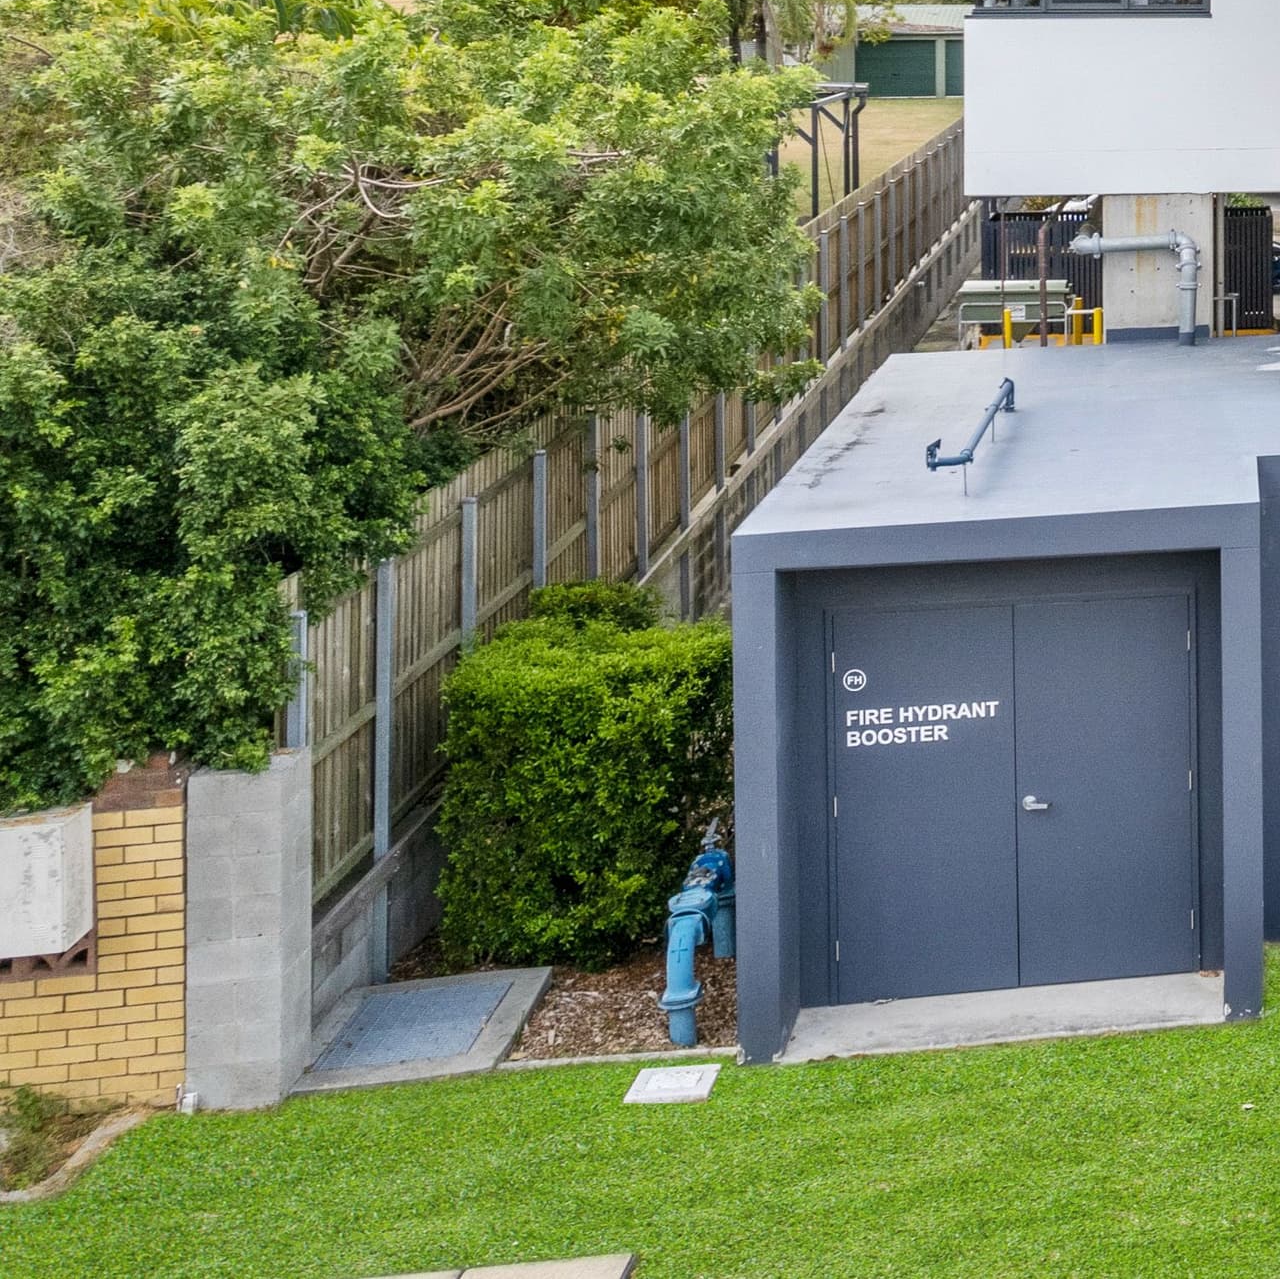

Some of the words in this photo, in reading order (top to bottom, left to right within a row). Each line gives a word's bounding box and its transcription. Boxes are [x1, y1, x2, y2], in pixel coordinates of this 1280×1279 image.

[846, 675, 863, 686] FH
[846, 708, 893, 726] FIRE
[899, 700, 999, 723] HYDRANT
[846, 724, 949, 747] BOOSTER
